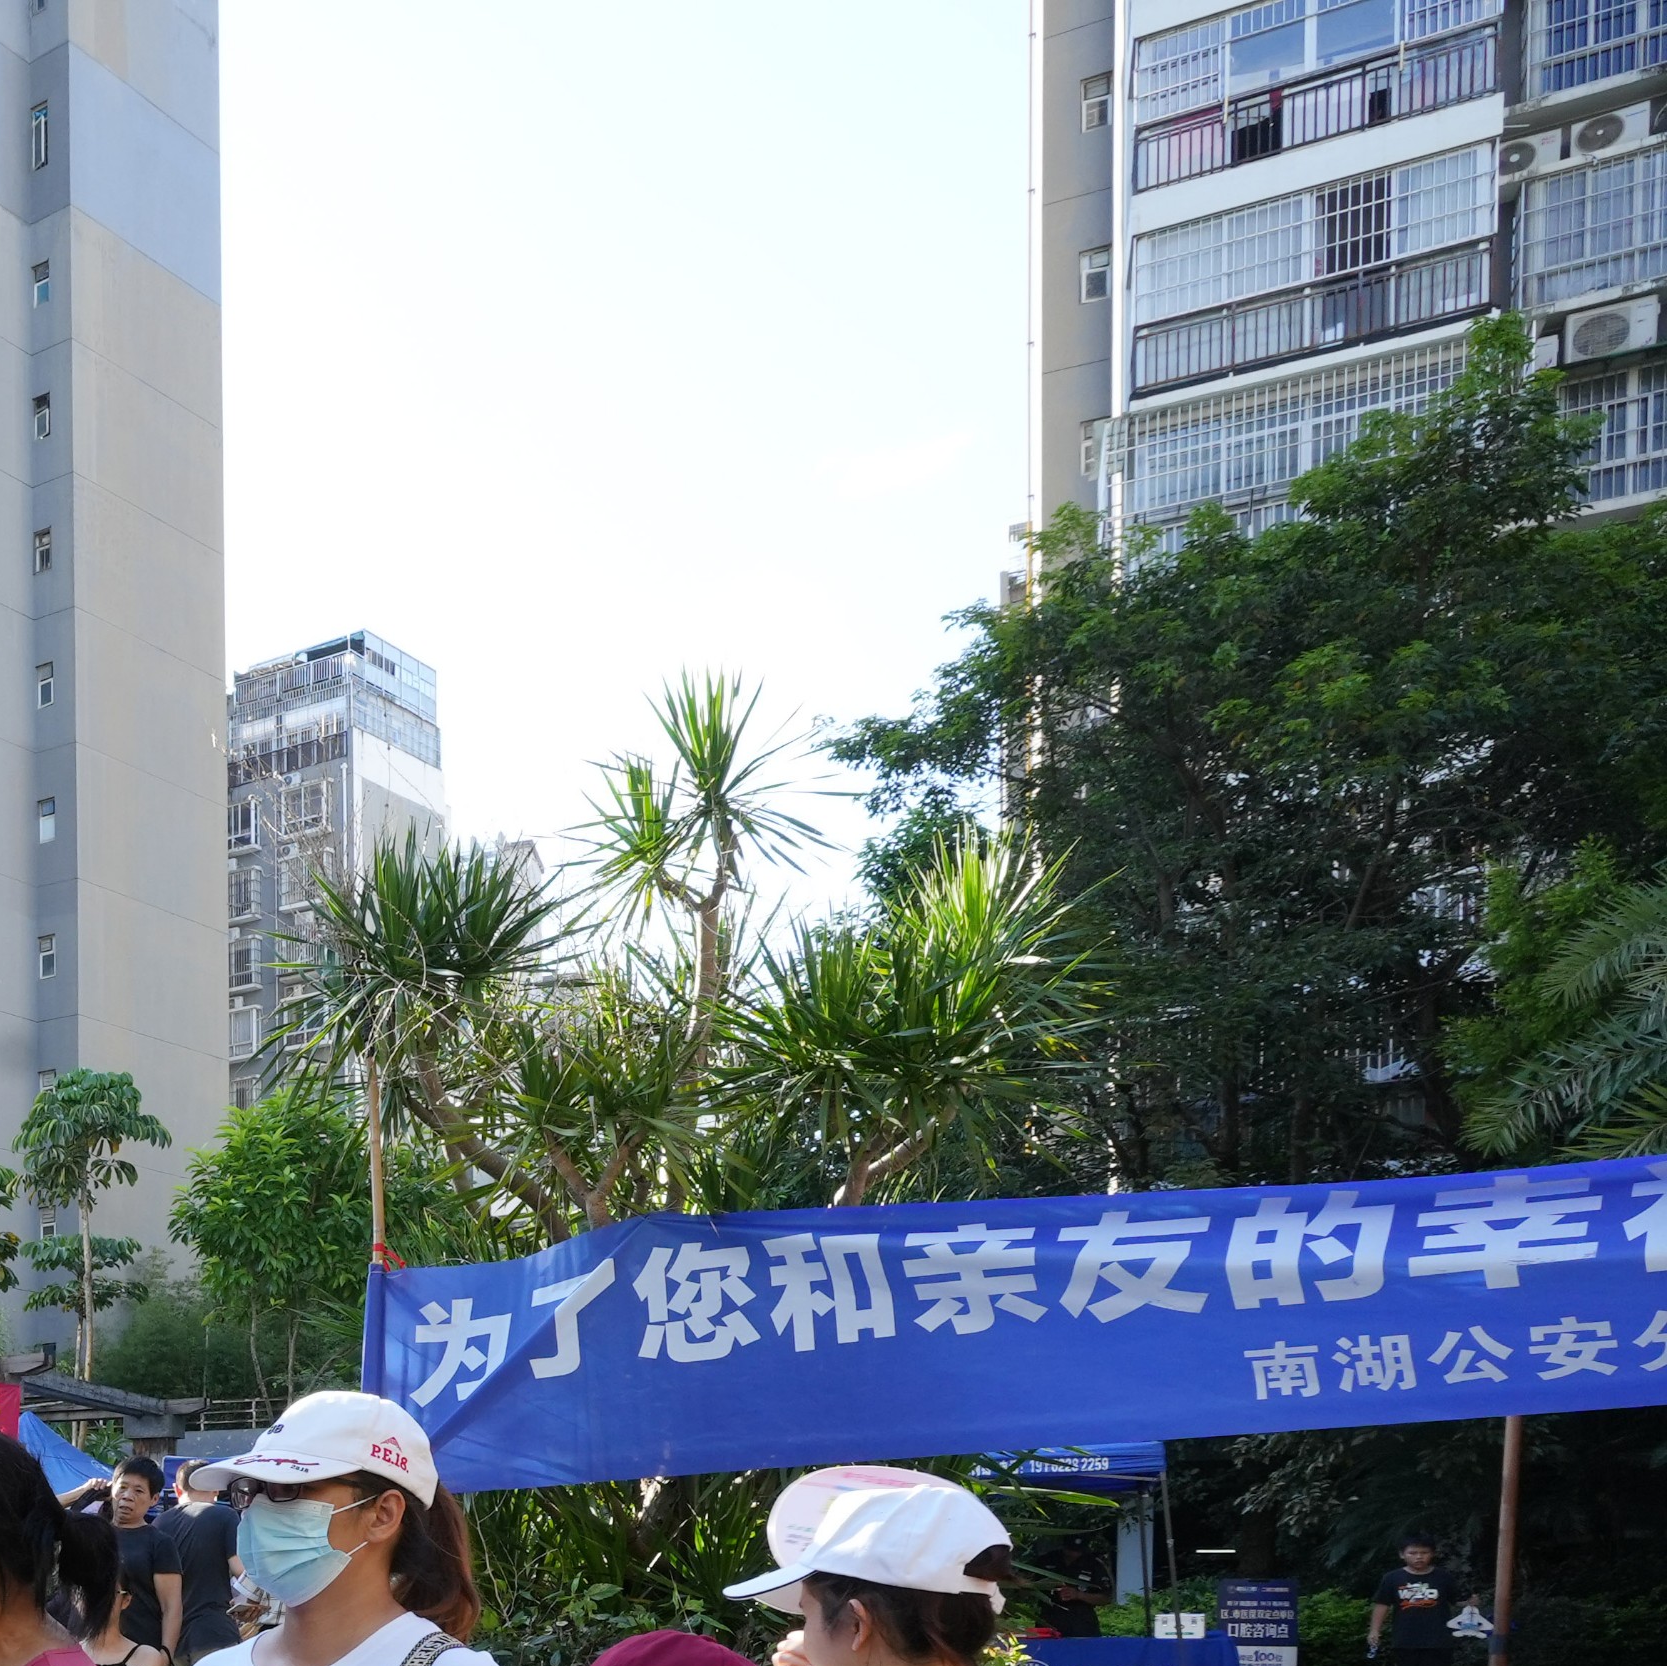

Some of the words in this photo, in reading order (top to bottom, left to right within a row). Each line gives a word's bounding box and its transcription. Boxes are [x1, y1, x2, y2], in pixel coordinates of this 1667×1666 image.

[409, 1161, 1667, 1408] 为了您和亲友的幸
[1227, 1623, 1289, 1639] 口腔咨询点
